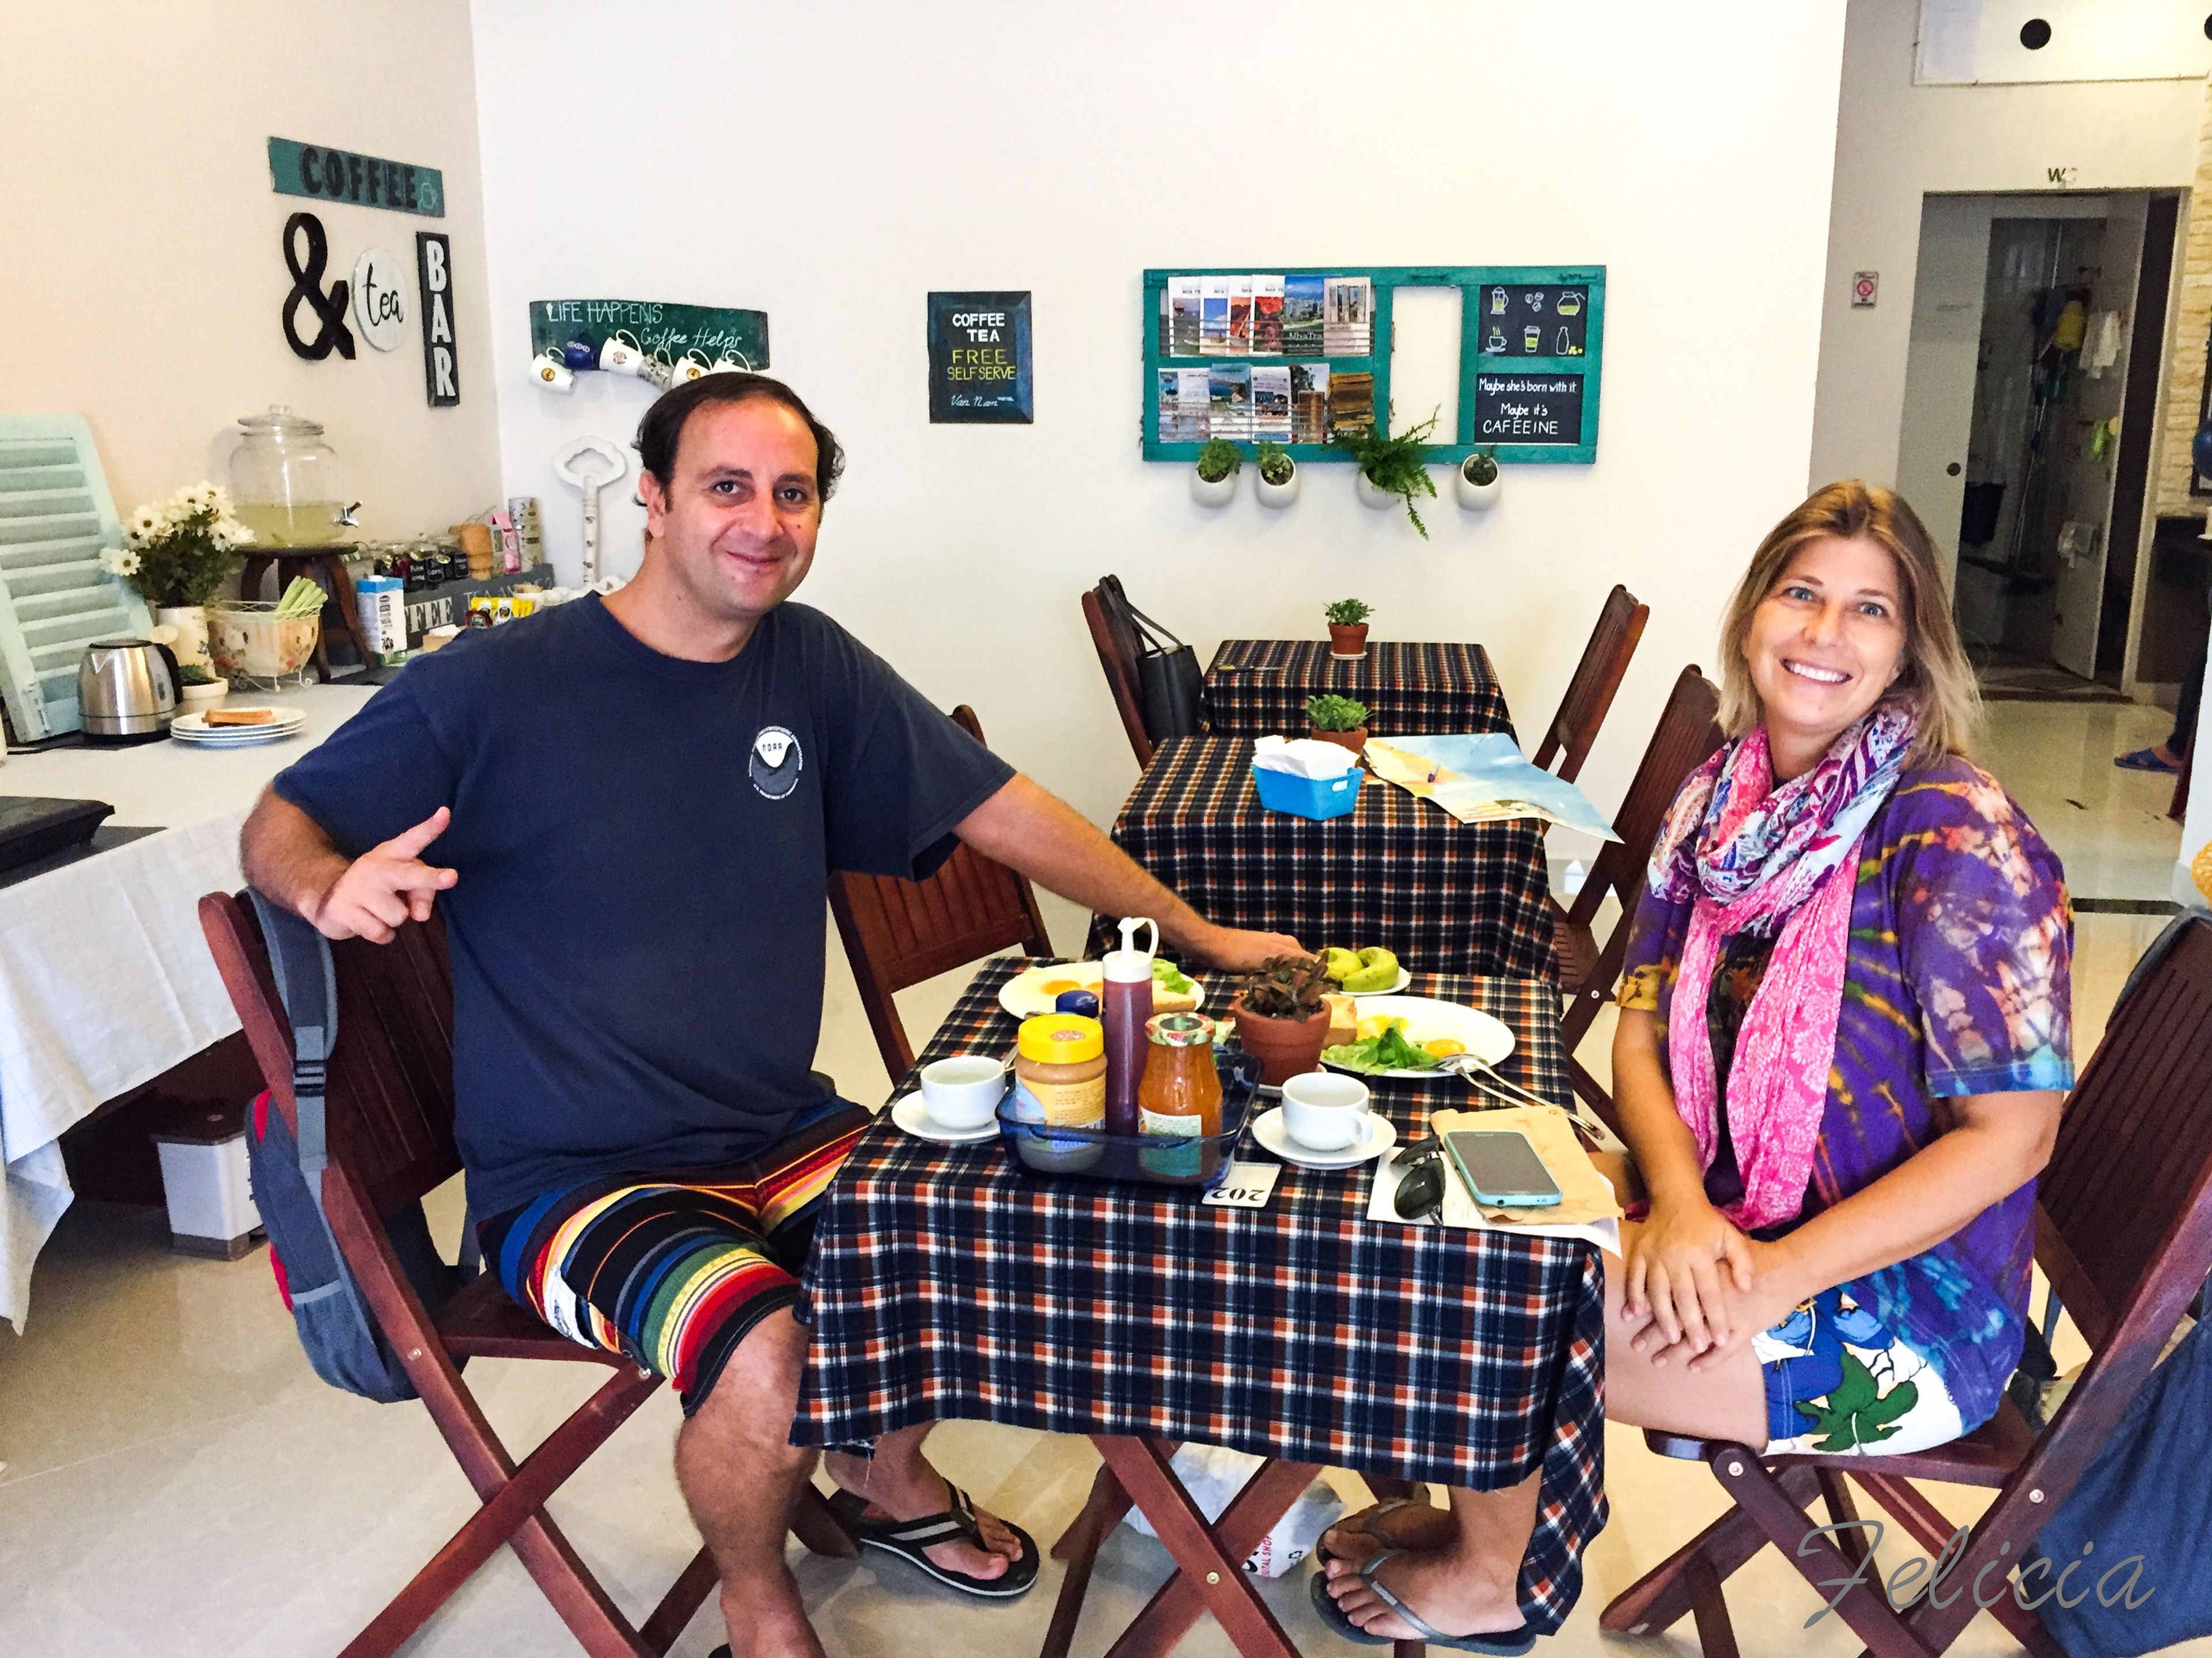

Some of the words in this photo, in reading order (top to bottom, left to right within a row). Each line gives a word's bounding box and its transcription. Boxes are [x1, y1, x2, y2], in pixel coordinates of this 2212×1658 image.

[299, 146, 418, 209] COFFEE
[362, 263, 403, 327] tea
[426, 240, 456, 397] BAR
[546, 302, 583, 323] LIFE
[587, 301, 663, 324] HAPPENS
[952, 313, 1005, 328] COFFEE
[641, 327, 688, 351] Coffee
[967, 328, 1000, 342] TEA
[952, 348, 1008, 365] FREE
[947, 367, 978, 381] SELF
[978, 366, 1016, 380] SERVE
[1479, 377, 1505, 396] Maybe
[1506, 379, 1526, 392] she's
[1527, 380, 1547, 393] born
[1549, 381, 1567, 393] with
[1569, 381, 1577, 393] it
[951, 394, 970, 407] Van
[1501, 403, 1529, 420] Maybe
[1533, 403, 1548, 416] it's
[1211, 1187, 1266, 1202] 202
